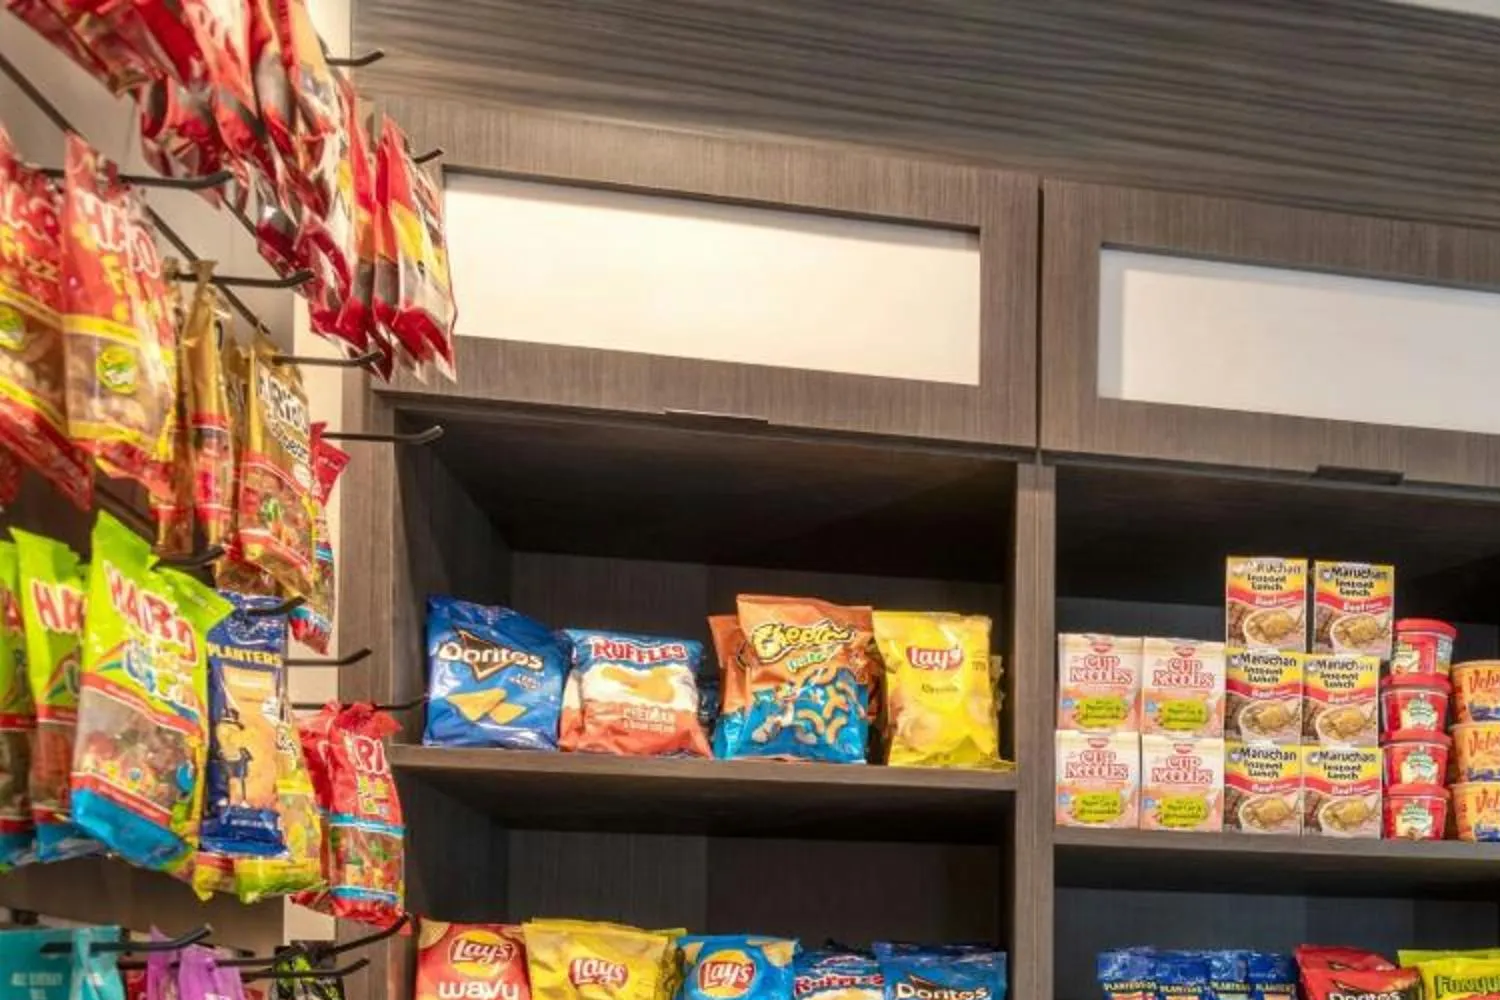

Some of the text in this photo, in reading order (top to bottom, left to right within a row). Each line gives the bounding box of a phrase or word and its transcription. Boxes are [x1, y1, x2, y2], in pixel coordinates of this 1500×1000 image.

[206, 642, 284, 668] PLANTERS
[438, 642, 544, 670] Doritos
[591, 638, 688, 664] RUFFLES
